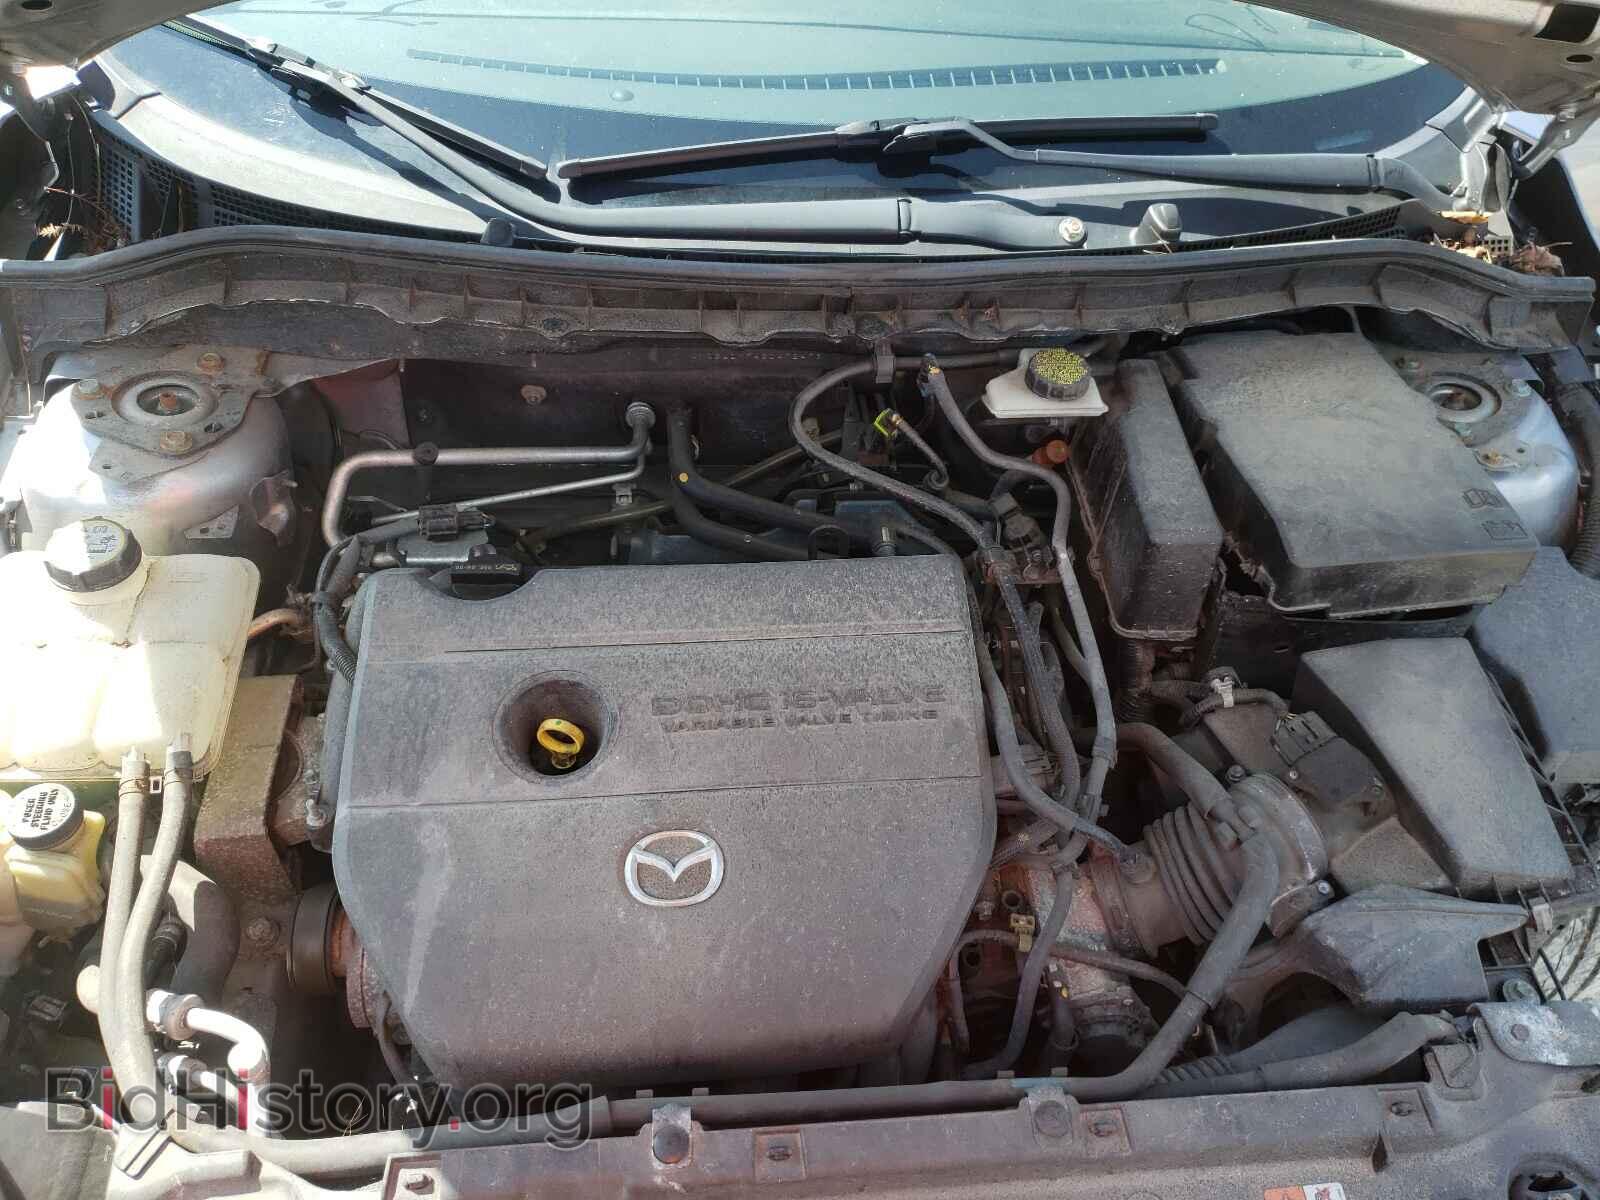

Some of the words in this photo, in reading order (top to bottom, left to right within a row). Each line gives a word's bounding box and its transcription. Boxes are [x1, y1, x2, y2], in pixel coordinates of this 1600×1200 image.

[21, 798, 36, 823] POWER
[31, 791, 49, 828] STEERING
[40, 808, 54, 831] FLUID
[47, 788, 59, 805] ONLY
